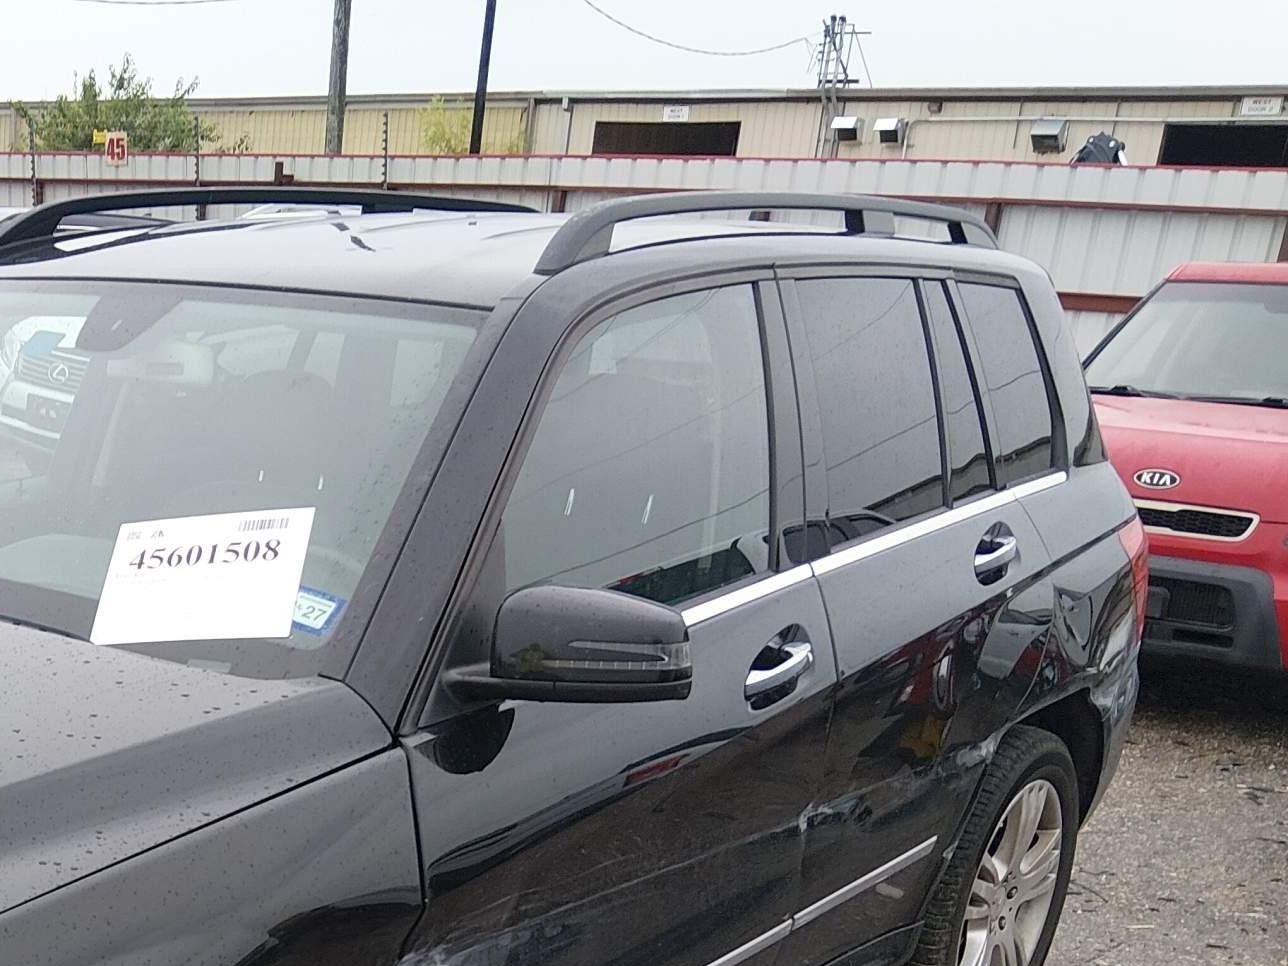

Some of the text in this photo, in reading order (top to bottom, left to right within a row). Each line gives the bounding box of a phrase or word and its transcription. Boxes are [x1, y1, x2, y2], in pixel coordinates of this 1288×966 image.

[107, 137, 126, 161] 45
[1141, 472, 1171, 486] KIA
[129, 538, 281, 570] 45601508
